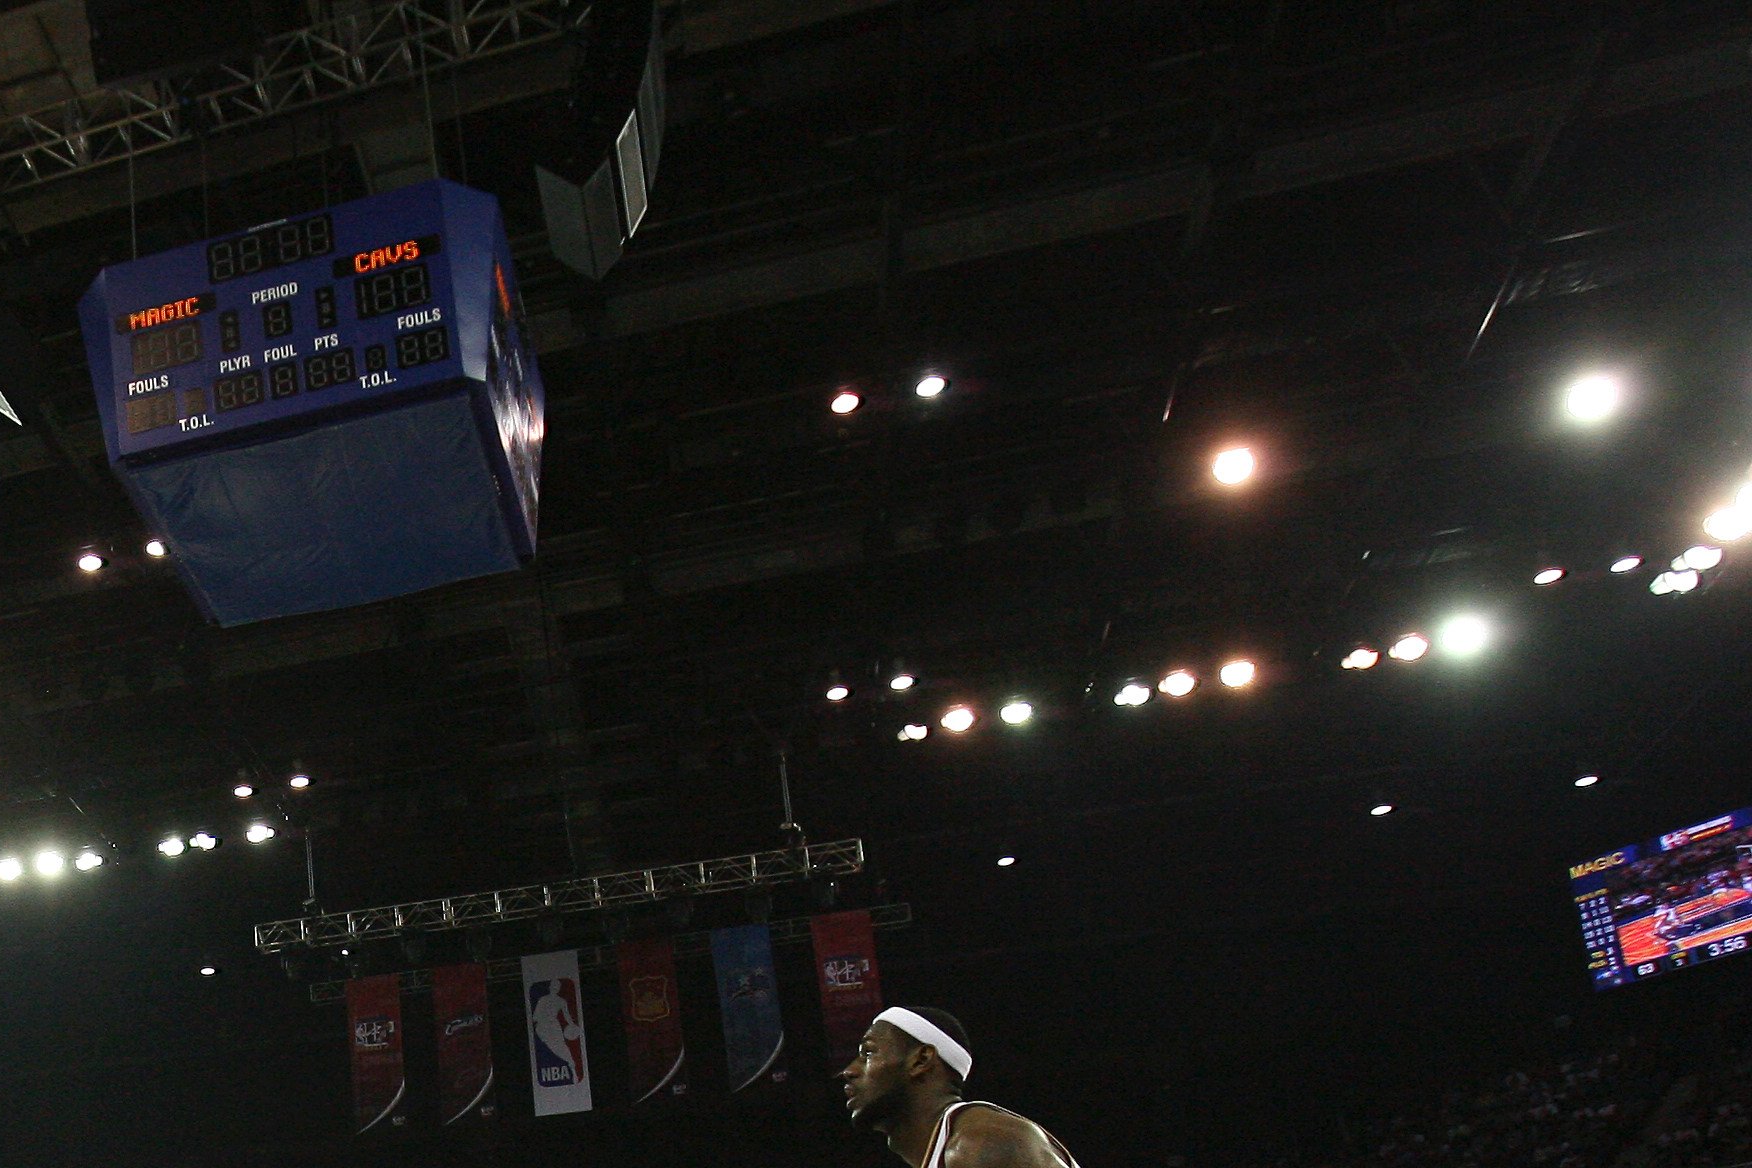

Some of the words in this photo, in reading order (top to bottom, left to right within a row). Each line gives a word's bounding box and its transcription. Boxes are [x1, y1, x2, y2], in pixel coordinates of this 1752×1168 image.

[354, 240, 420, 275] CAVS
[251, 282, 298, 304] PERIOD
[129, 297, 201, 331] MAGIC
[397, 308, 442, 331] FOULS
[219, 354, 251, 373] PLYR
[263, 344, 297, 364] FOUL
[313, 334, 339, 352] PTS
[128, 374, 169, 396] FOULS
[359, 371, 398, 390] T.O.L.
[179, 413, 216, 433] T.O.L.
[1569, 852, 1624, 880] MAGIC
[540, 1065, 570, 1082] NBA
